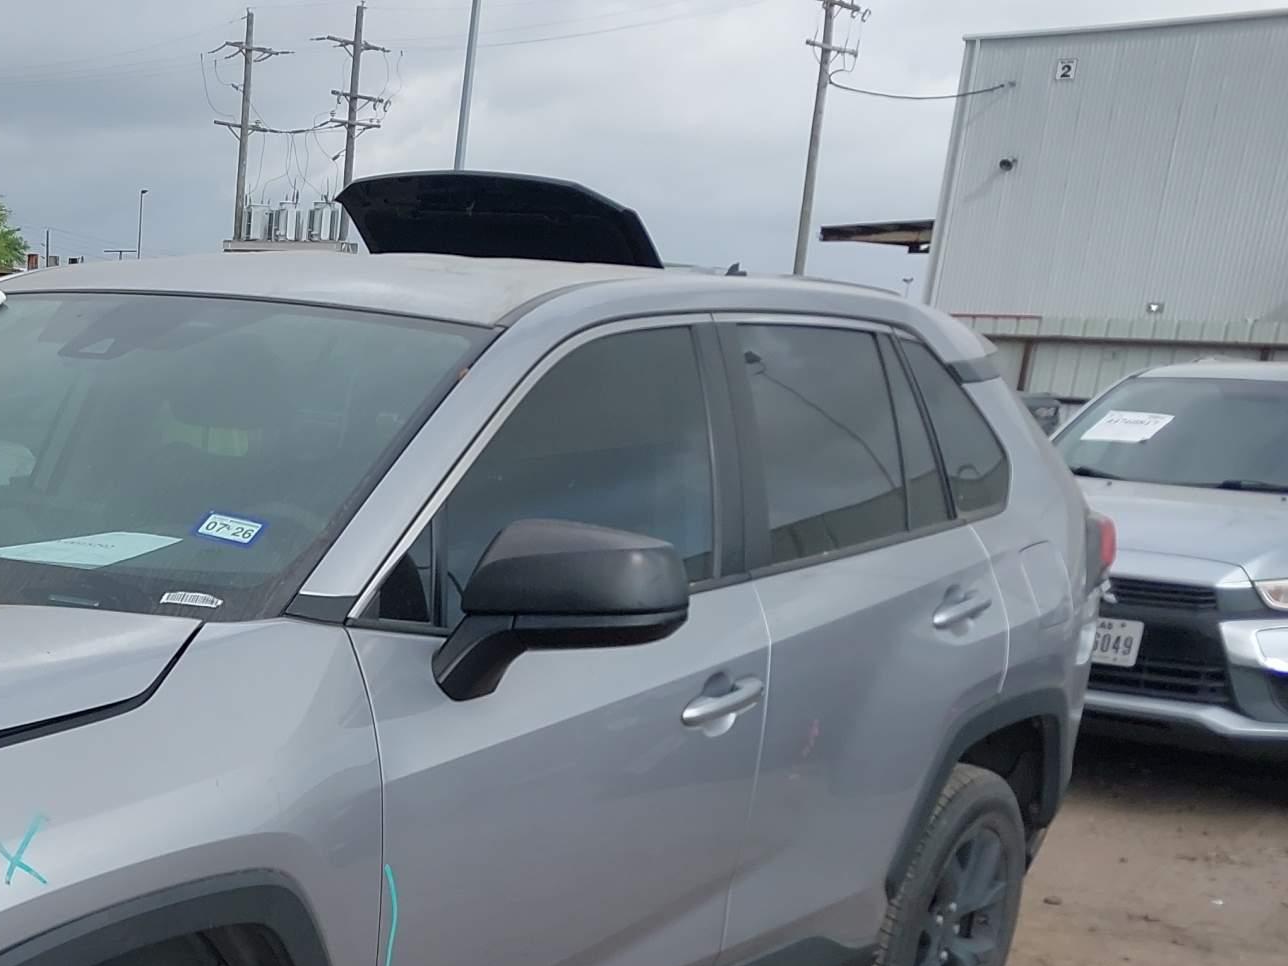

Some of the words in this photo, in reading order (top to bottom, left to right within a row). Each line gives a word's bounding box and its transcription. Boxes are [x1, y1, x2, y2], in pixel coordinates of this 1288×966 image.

[1060, 65, 1071, 77] 2
[205, 520, 228, 534] 07
[231, 526, 255, 540] 26
